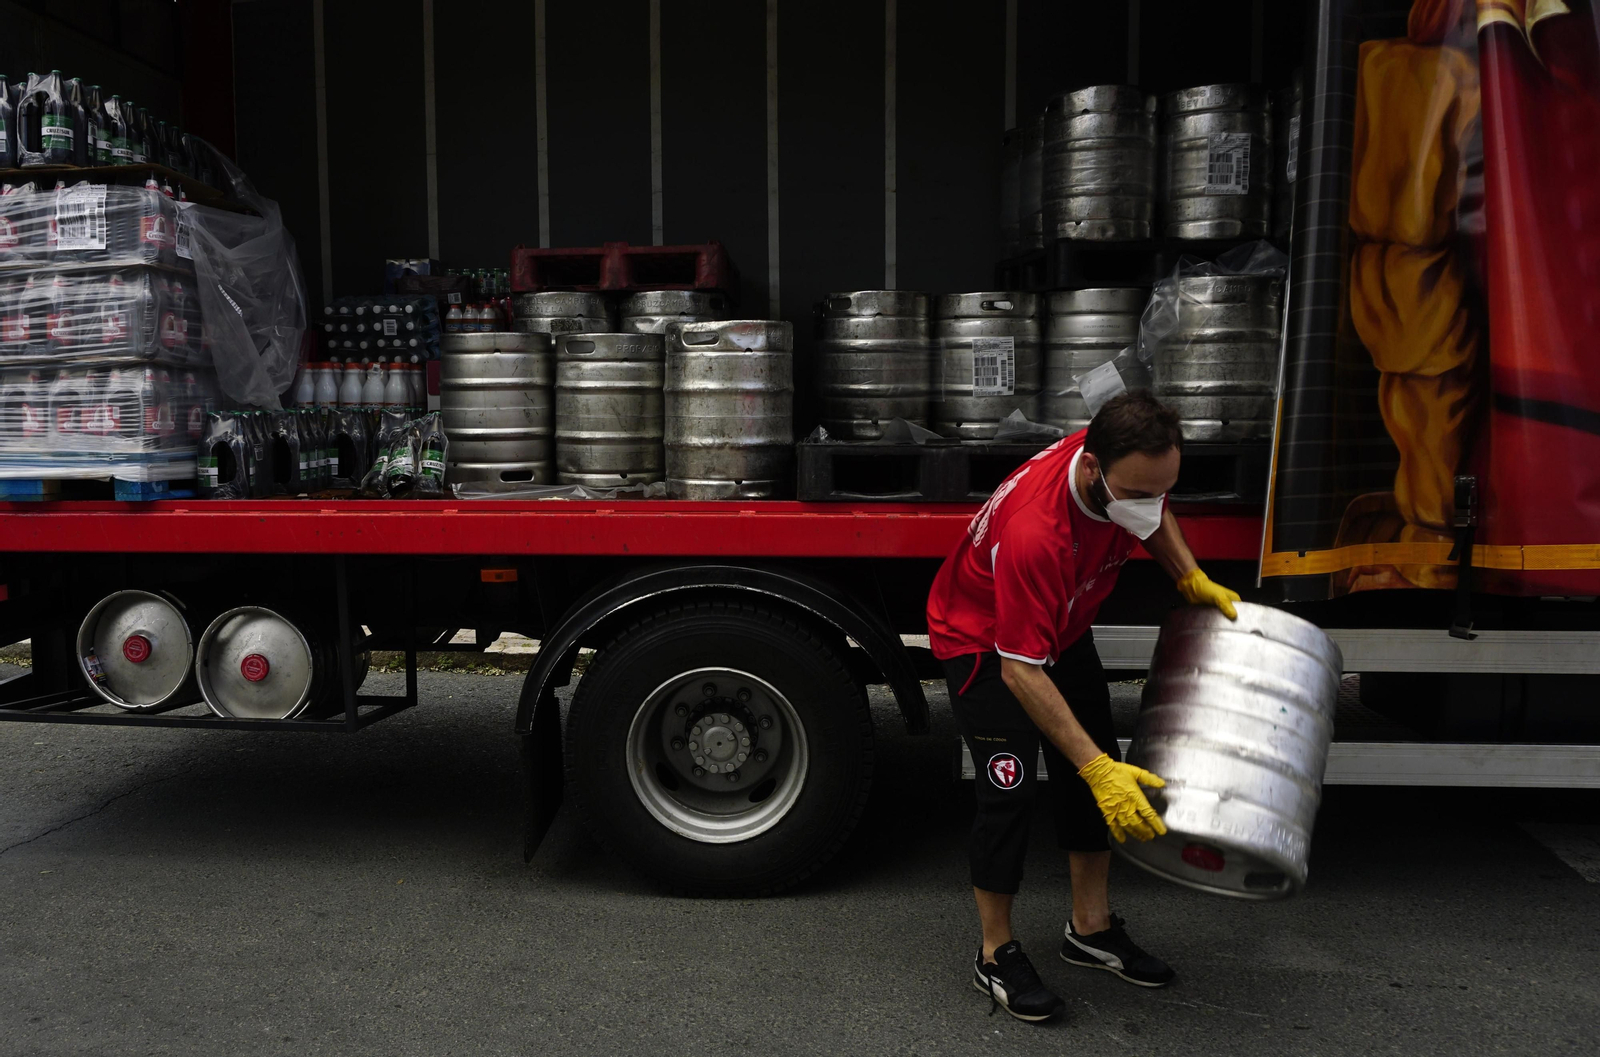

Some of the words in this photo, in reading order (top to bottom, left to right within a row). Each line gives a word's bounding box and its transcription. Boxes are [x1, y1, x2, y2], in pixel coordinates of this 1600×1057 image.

[1181, 97, 1228, 109] SEVILLA
[554, 297, 585, 305] CAMPO
[524, 306, 564, 314] SEVILLA
